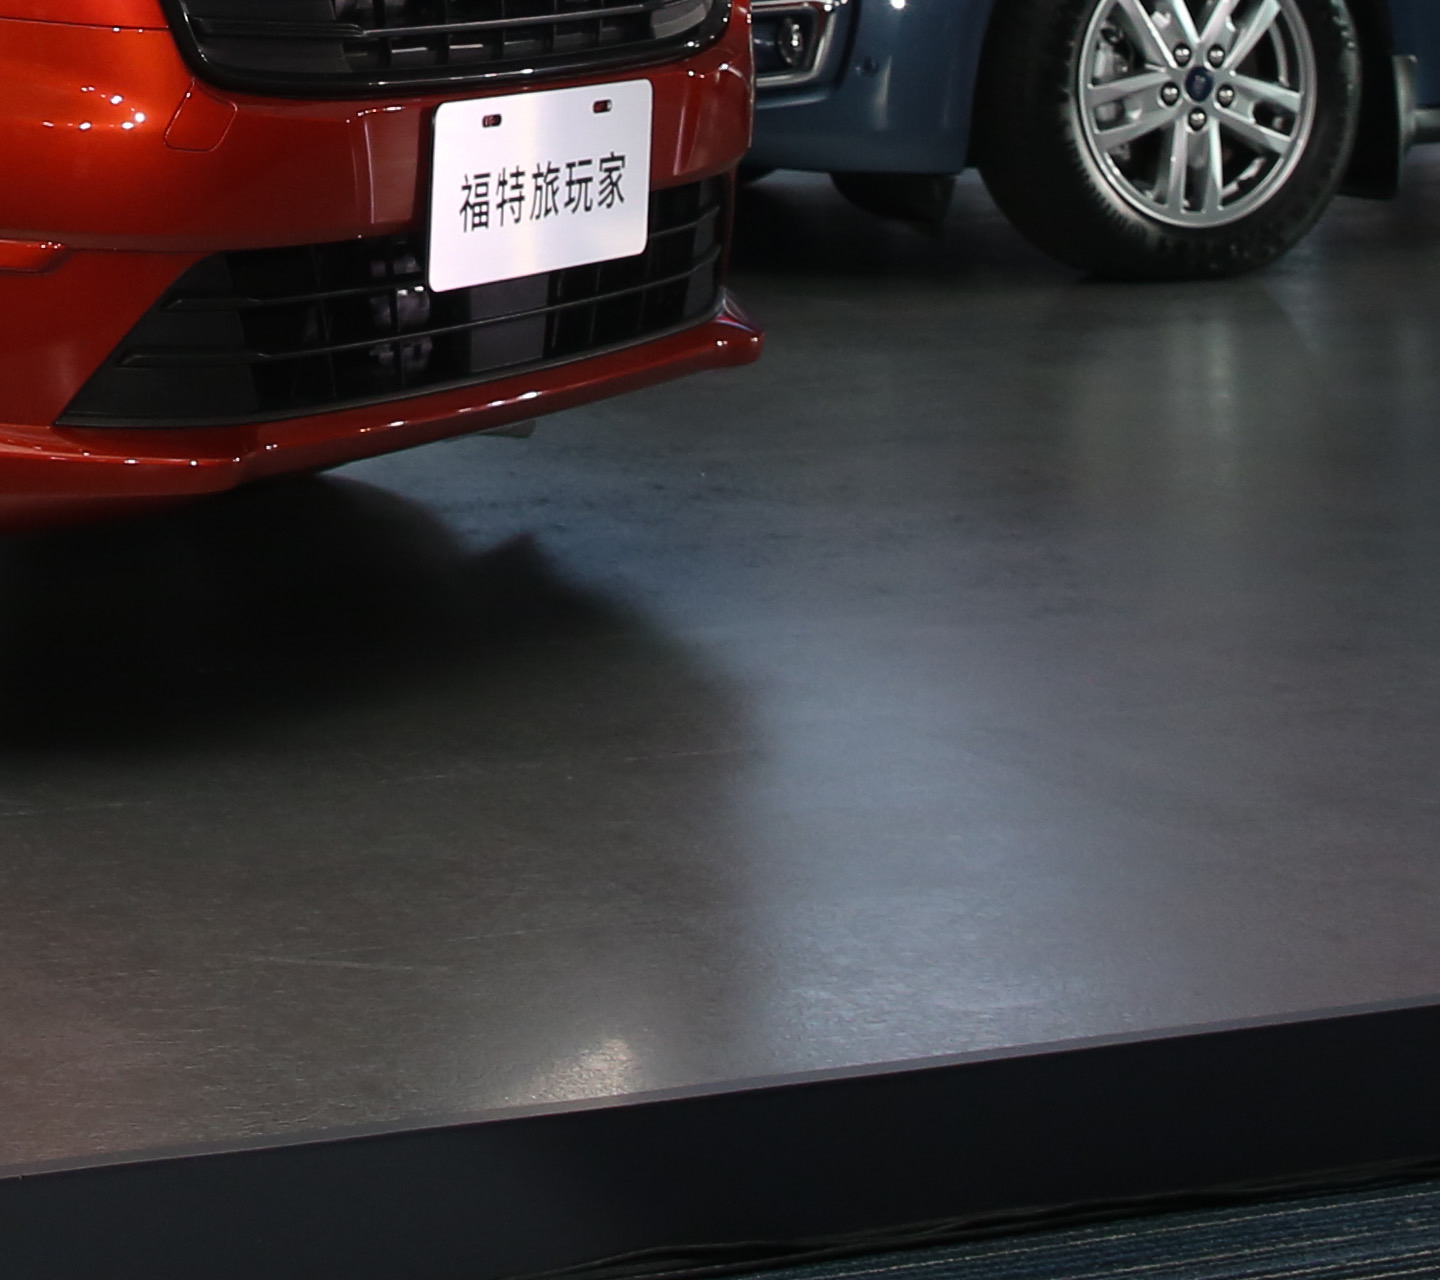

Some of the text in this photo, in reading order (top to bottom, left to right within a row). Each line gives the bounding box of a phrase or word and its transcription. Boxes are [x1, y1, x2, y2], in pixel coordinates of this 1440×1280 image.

[459, 151, 626, 233] 福特旅玩家
